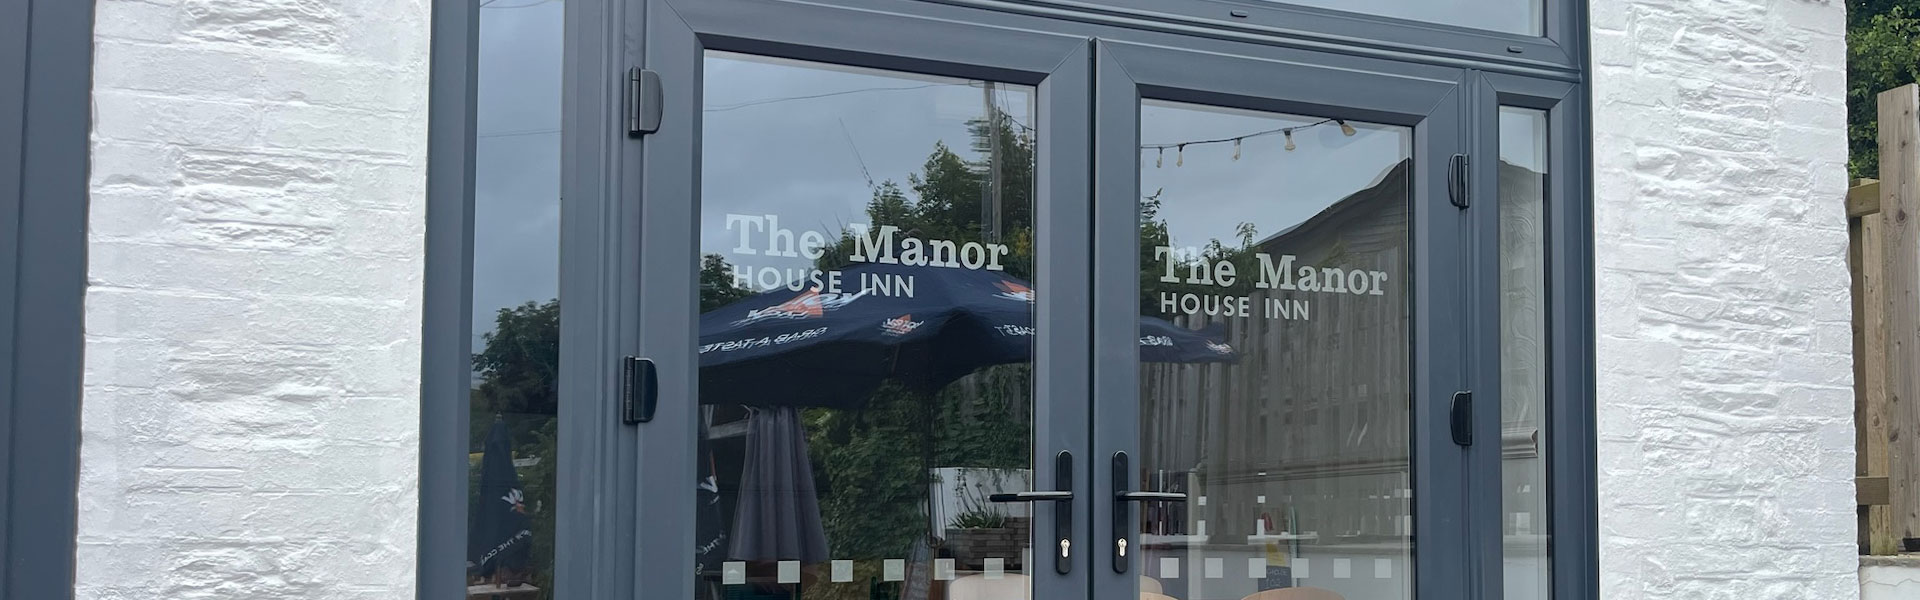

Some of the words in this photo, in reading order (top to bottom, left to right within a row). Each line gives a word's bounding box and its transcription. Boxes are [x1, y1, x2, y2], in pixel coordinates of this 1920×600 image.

[726, 213, 826, 260] The
[849, 223, 1009, 271] Manor
[733, 265, 842, 294] HOUSE
[861, 272, 915, 298] INN
[1155, 246, 1236, 288] The
[1255, 253, 1388, 296] Manor
[1160, 291, 1250, 318] HOUSE
[1265, 299, 1310, 321] INN
